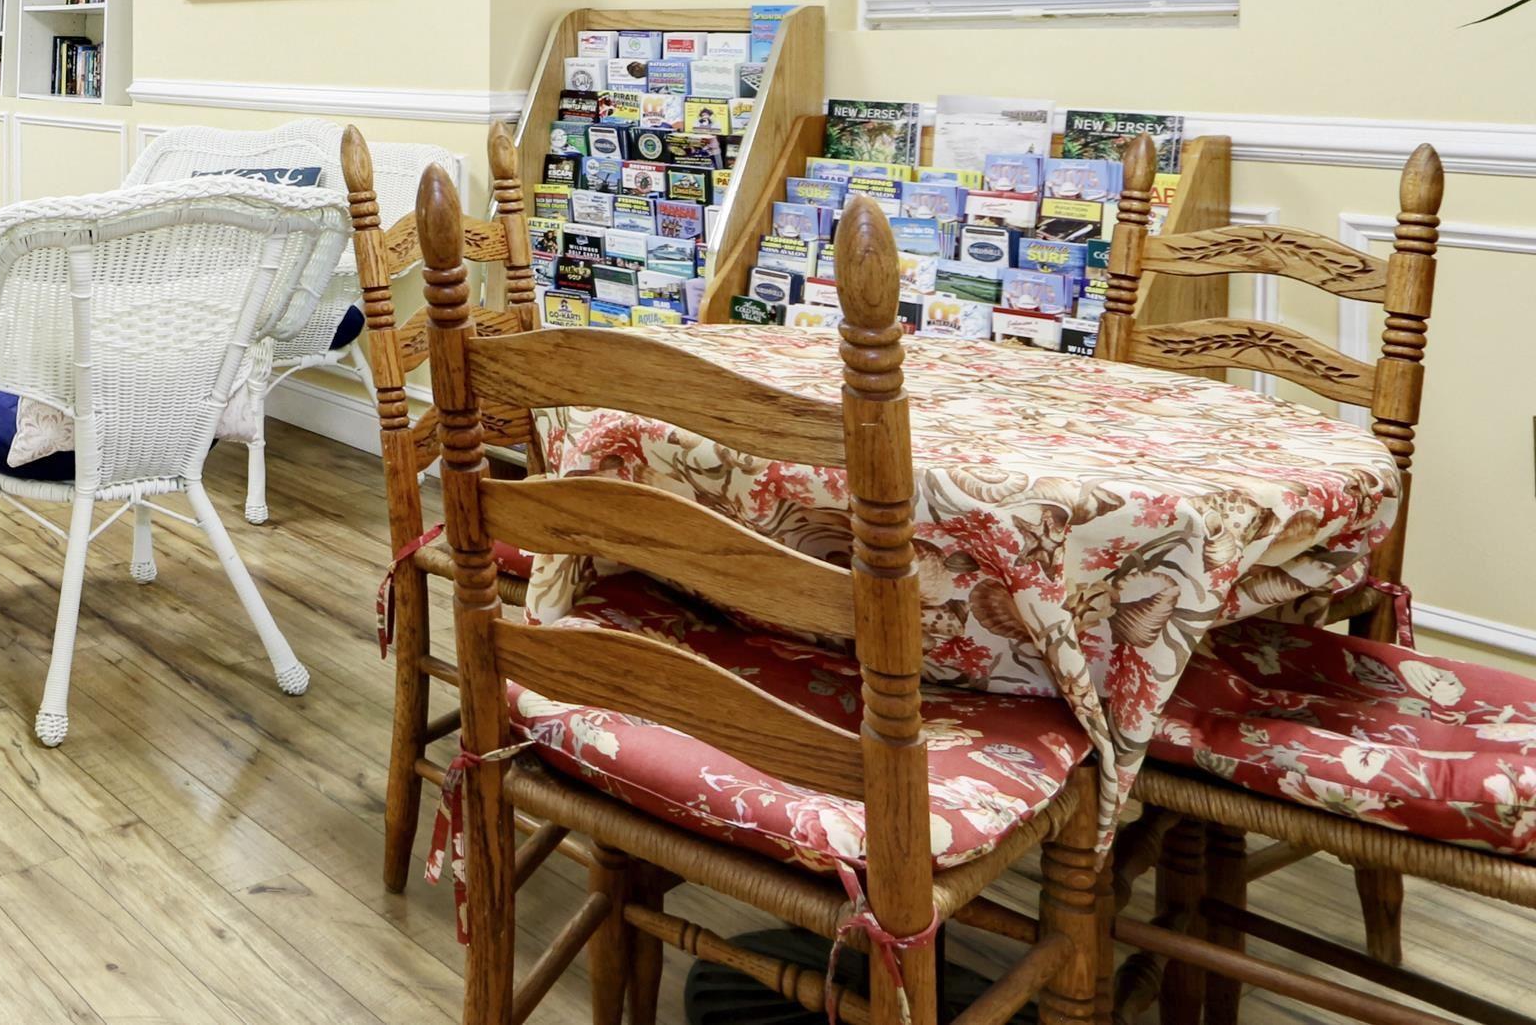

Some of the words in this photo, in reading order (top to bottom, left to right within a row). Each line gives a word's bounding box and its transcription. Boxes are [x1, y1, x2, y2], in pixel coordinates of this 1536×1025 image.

[613, 92, 638, 102] PIRATE
[834, 106, 858, 117] NEW
[859, 107, 904, 120] JERSEY
[1074, 119, 1104, 131] NEW
[1106, 121, 1165, 135] JERSEY
[852, 178, 894, 186] FISHING
[796, 187, 831, 200] SURF
[765, 236, 805, 246] FISHING
[779, 248, 806, 257] AVALON
[1027, 250, 1070, 264] SURF
